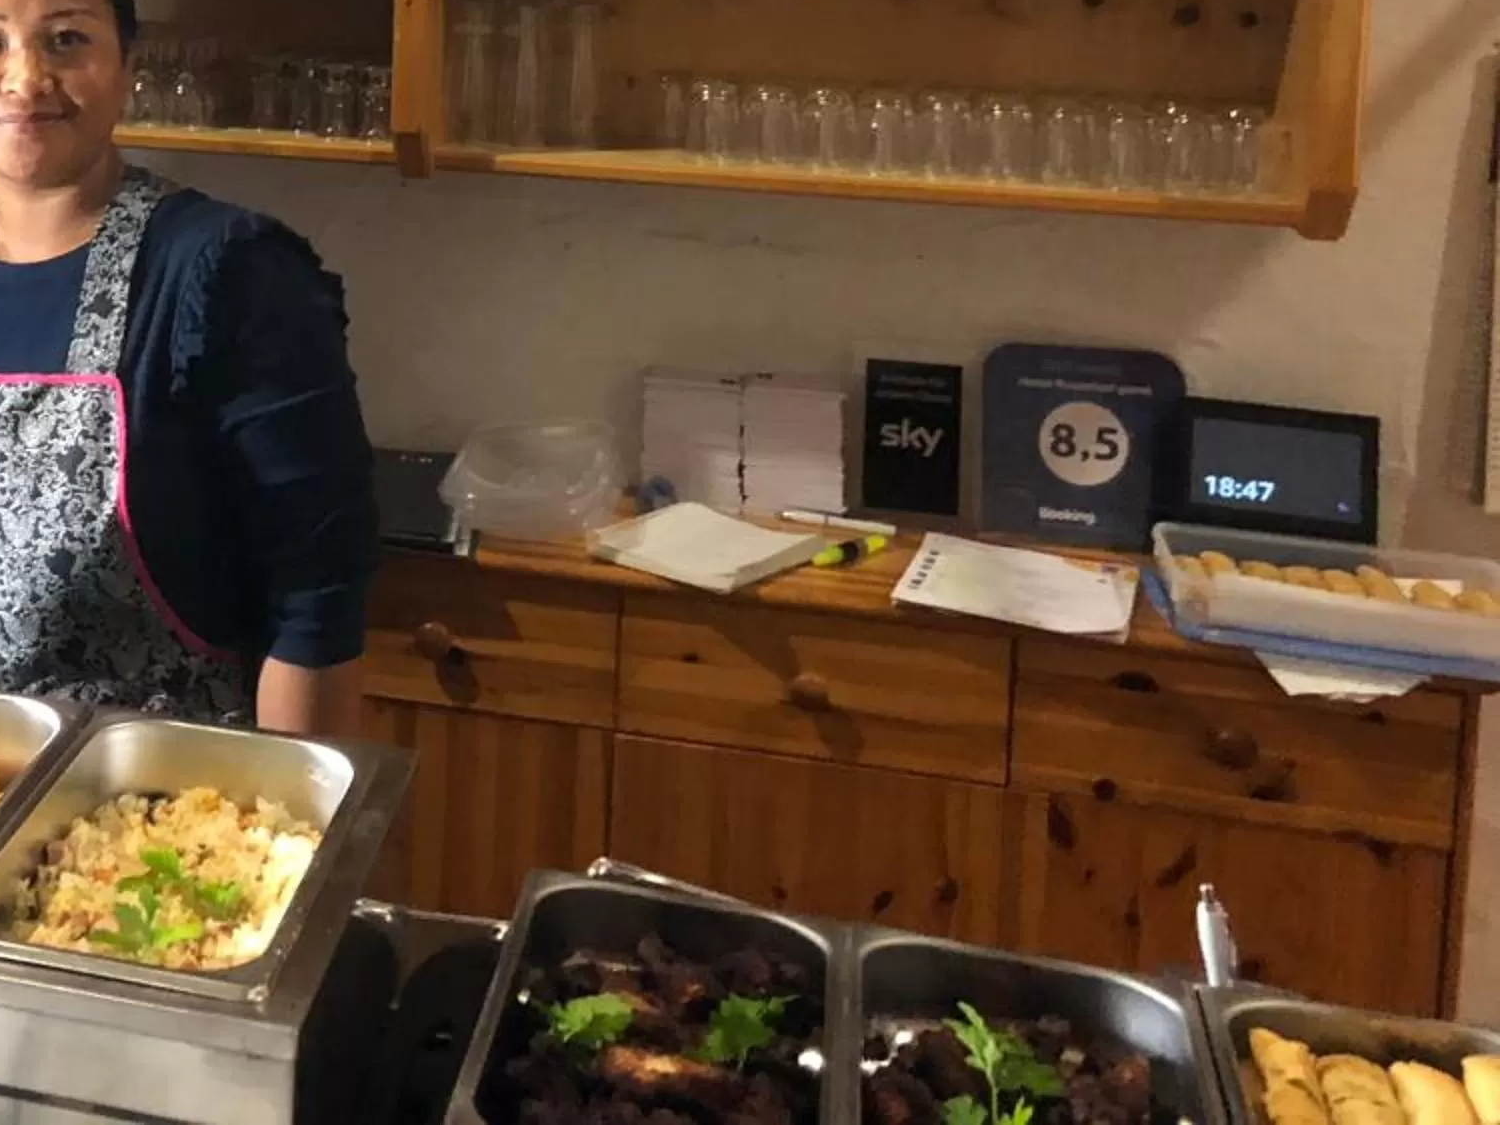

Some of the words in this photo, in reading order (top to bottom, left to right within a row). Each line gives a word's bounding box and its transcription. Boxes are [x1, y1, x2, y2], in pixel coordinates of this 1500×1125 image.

[879, 418, 944, 458] sky
[1051, 423, 1119, 462] 8,5
[1204, 475, 1276, 502] 18:47
